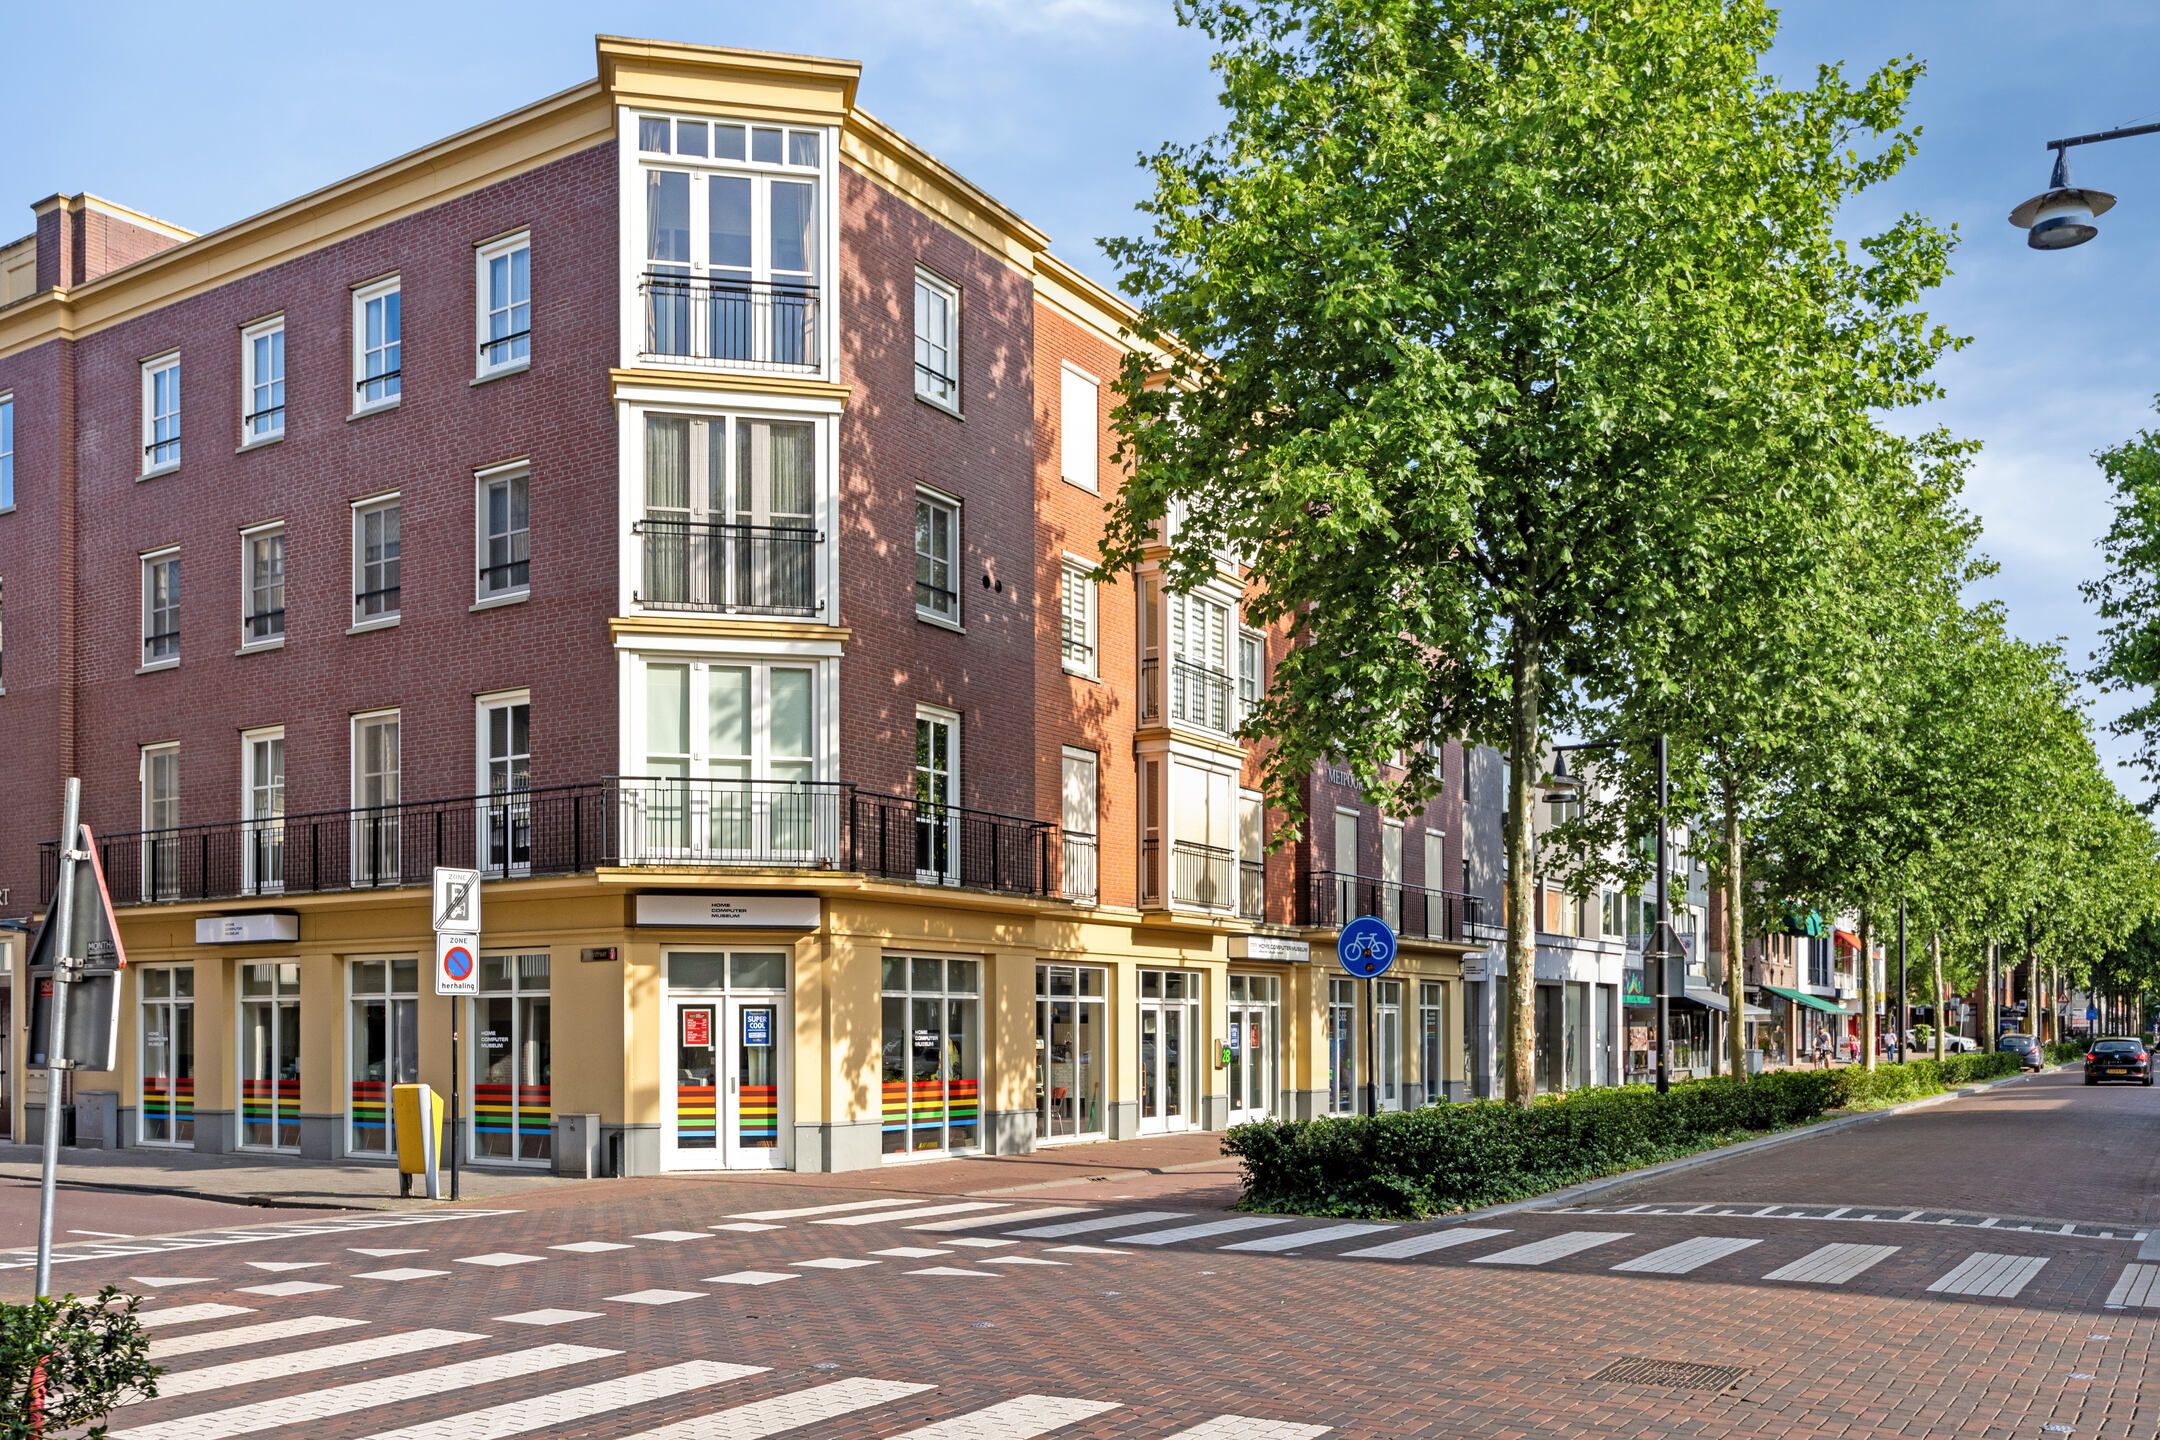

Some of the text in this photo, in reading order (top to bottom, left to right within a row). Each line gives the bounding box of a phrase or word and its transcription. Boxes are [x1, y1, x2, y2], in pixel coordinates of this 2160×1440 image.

[448, 873, 467, 881] ZONE
[441, 982, 475, 990] herhaling
[747, 1015, 768, 1023] SUPER
[1222, 1048, 1231, 1063] 28
